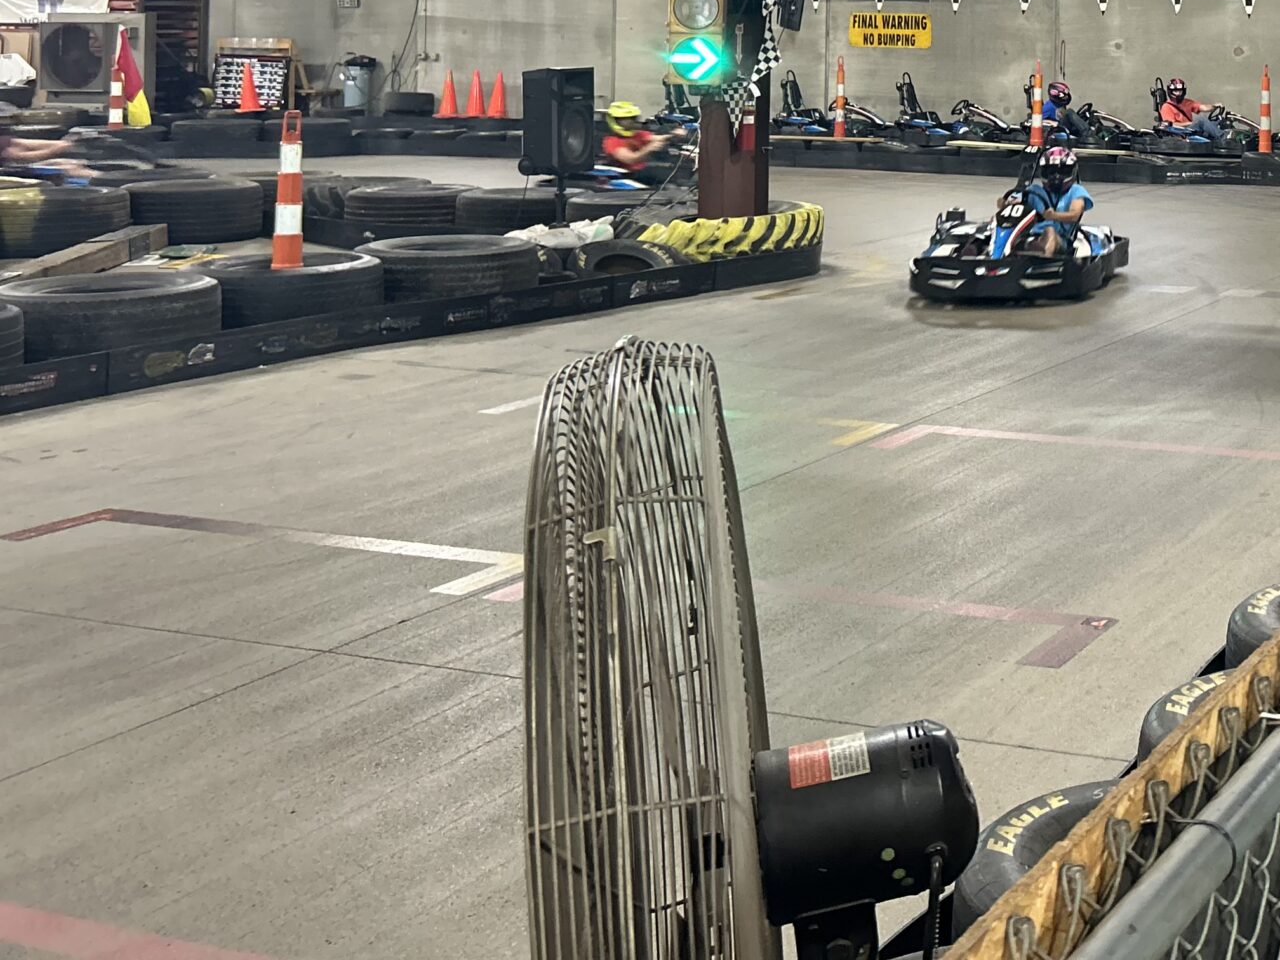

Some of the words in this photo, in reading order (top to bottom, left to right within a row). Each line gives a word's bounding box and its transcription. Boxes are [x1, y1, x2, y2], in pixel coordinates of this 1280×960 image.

[852, 14, 878, 30] FINAL
[881, 14, 927, 31] WARNING
[863, 33, 875, 46] NO
[877, 33, 916, 47] BUMPING
[1001, 204, 1025, 217] 40
[1166, 671, 1227, 715] EAGLE
[987, 794, 1069, 856] EAGLE
